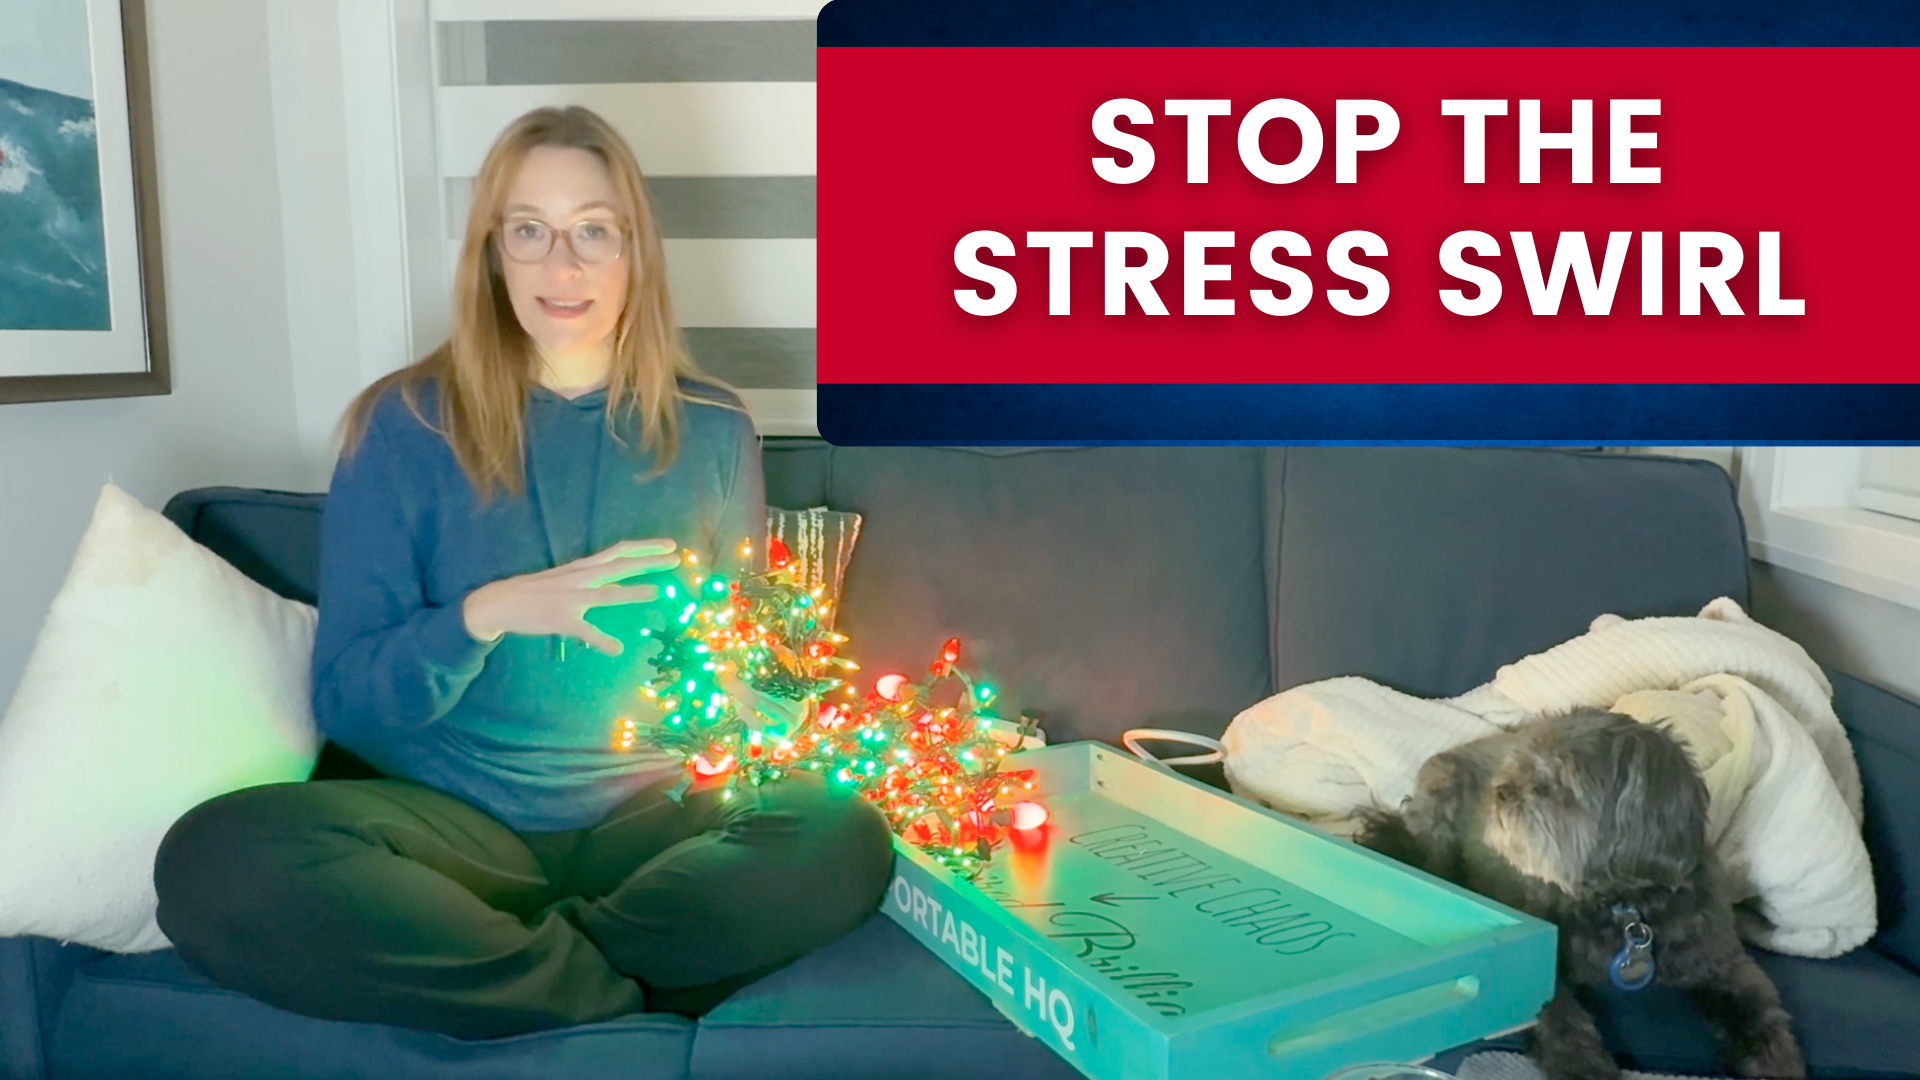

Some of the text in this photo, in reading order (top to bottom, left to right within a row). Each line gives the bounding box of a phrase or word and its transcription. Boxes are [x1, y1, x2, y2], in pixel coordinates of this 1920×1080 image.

[888, 875, 1077, 1051] ORTABLE HQ
[1069, 824, 1356, 955] CREATIVE CHAOS
